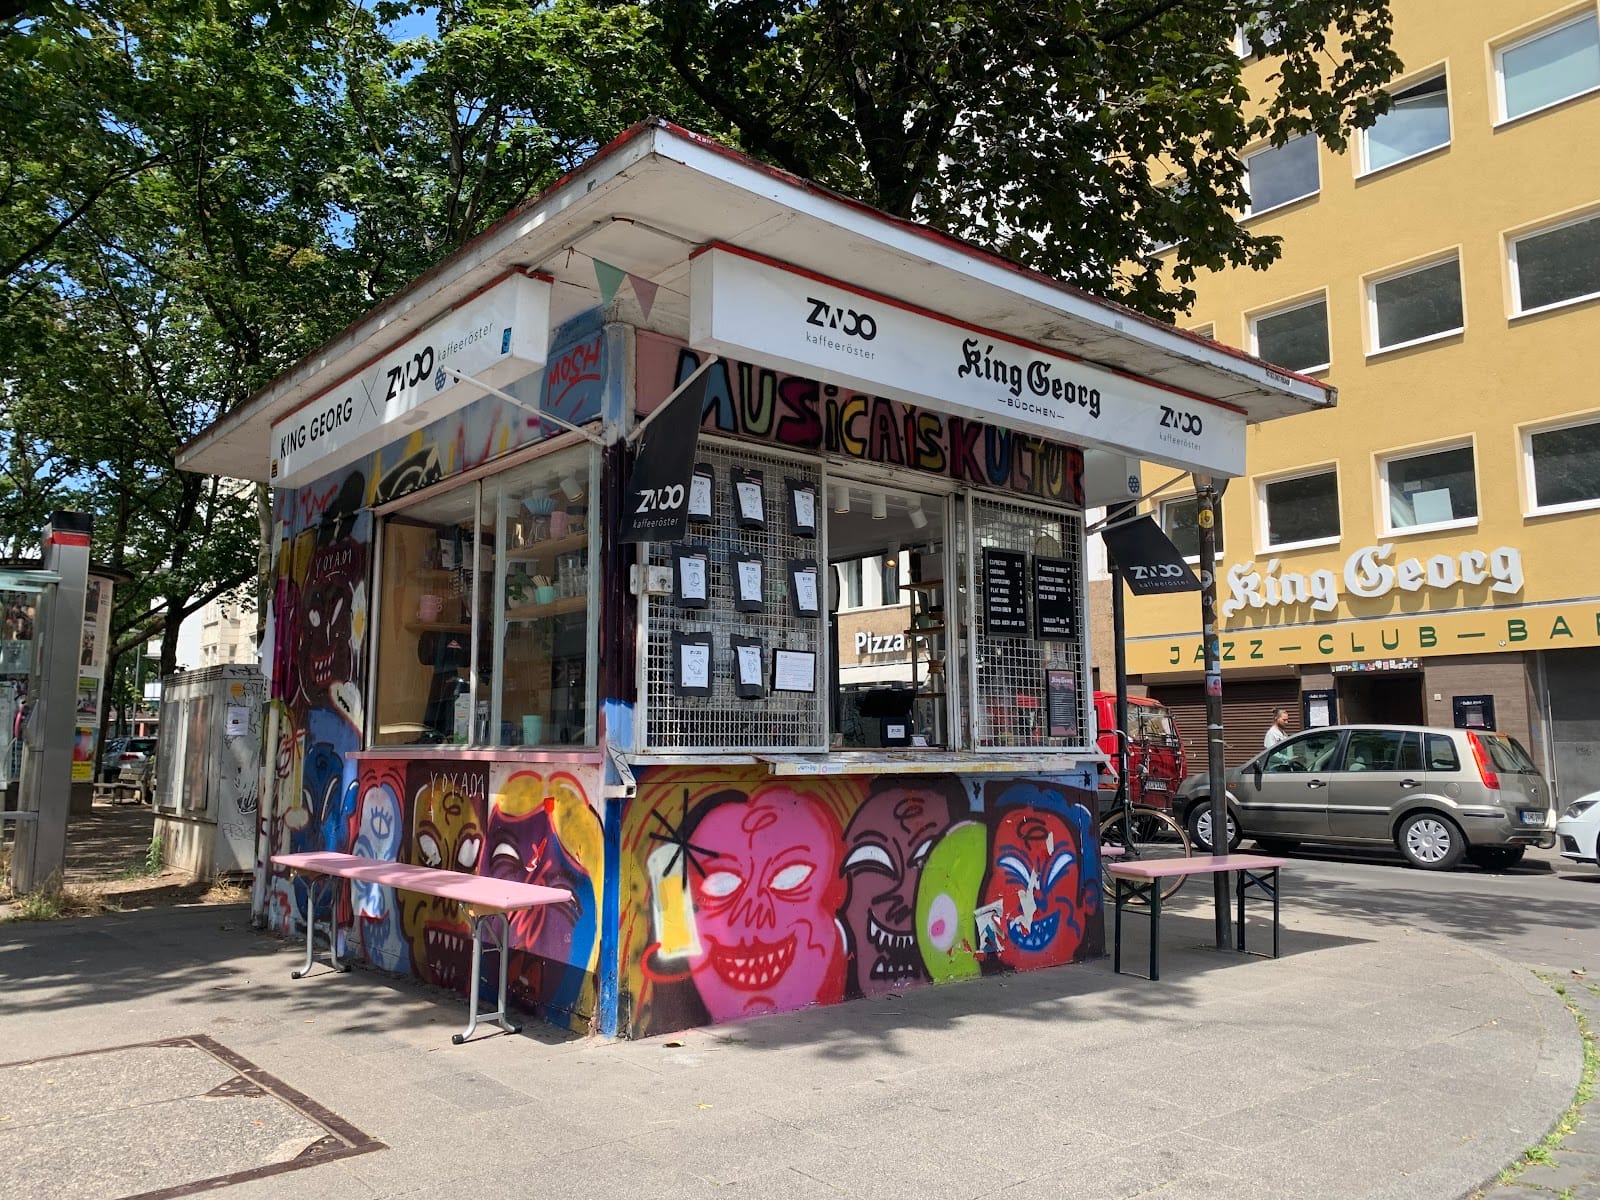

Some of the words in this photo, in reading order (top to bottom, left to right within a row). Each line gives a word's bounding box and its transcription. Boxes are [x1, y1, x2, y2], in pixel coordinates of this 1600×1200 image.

[805, 331, 875, 360] kaffeeröster
[280, 425, 306, 459] KING
[310, 397, 352, 438] GEORG
[437, 321, 494, 362] kaffeeröster
[958, 338, 1022, 396] King
[1027, 360, 1101, 419] Georg
[1007, 398, 1056, 418] BÜDCHEN
[1159, 434, 1201, 451] kaffeeröster
[633, 517, 679, 529] kaffeeröster
[1222, 558, 1339, 618] King
[1343, 543, 1525, 598] Georg
[854, 632, 905, 655] Pizza
[1318, 626, 1438, 654] CLUB
[1507, 612, 1600, 642] BA
